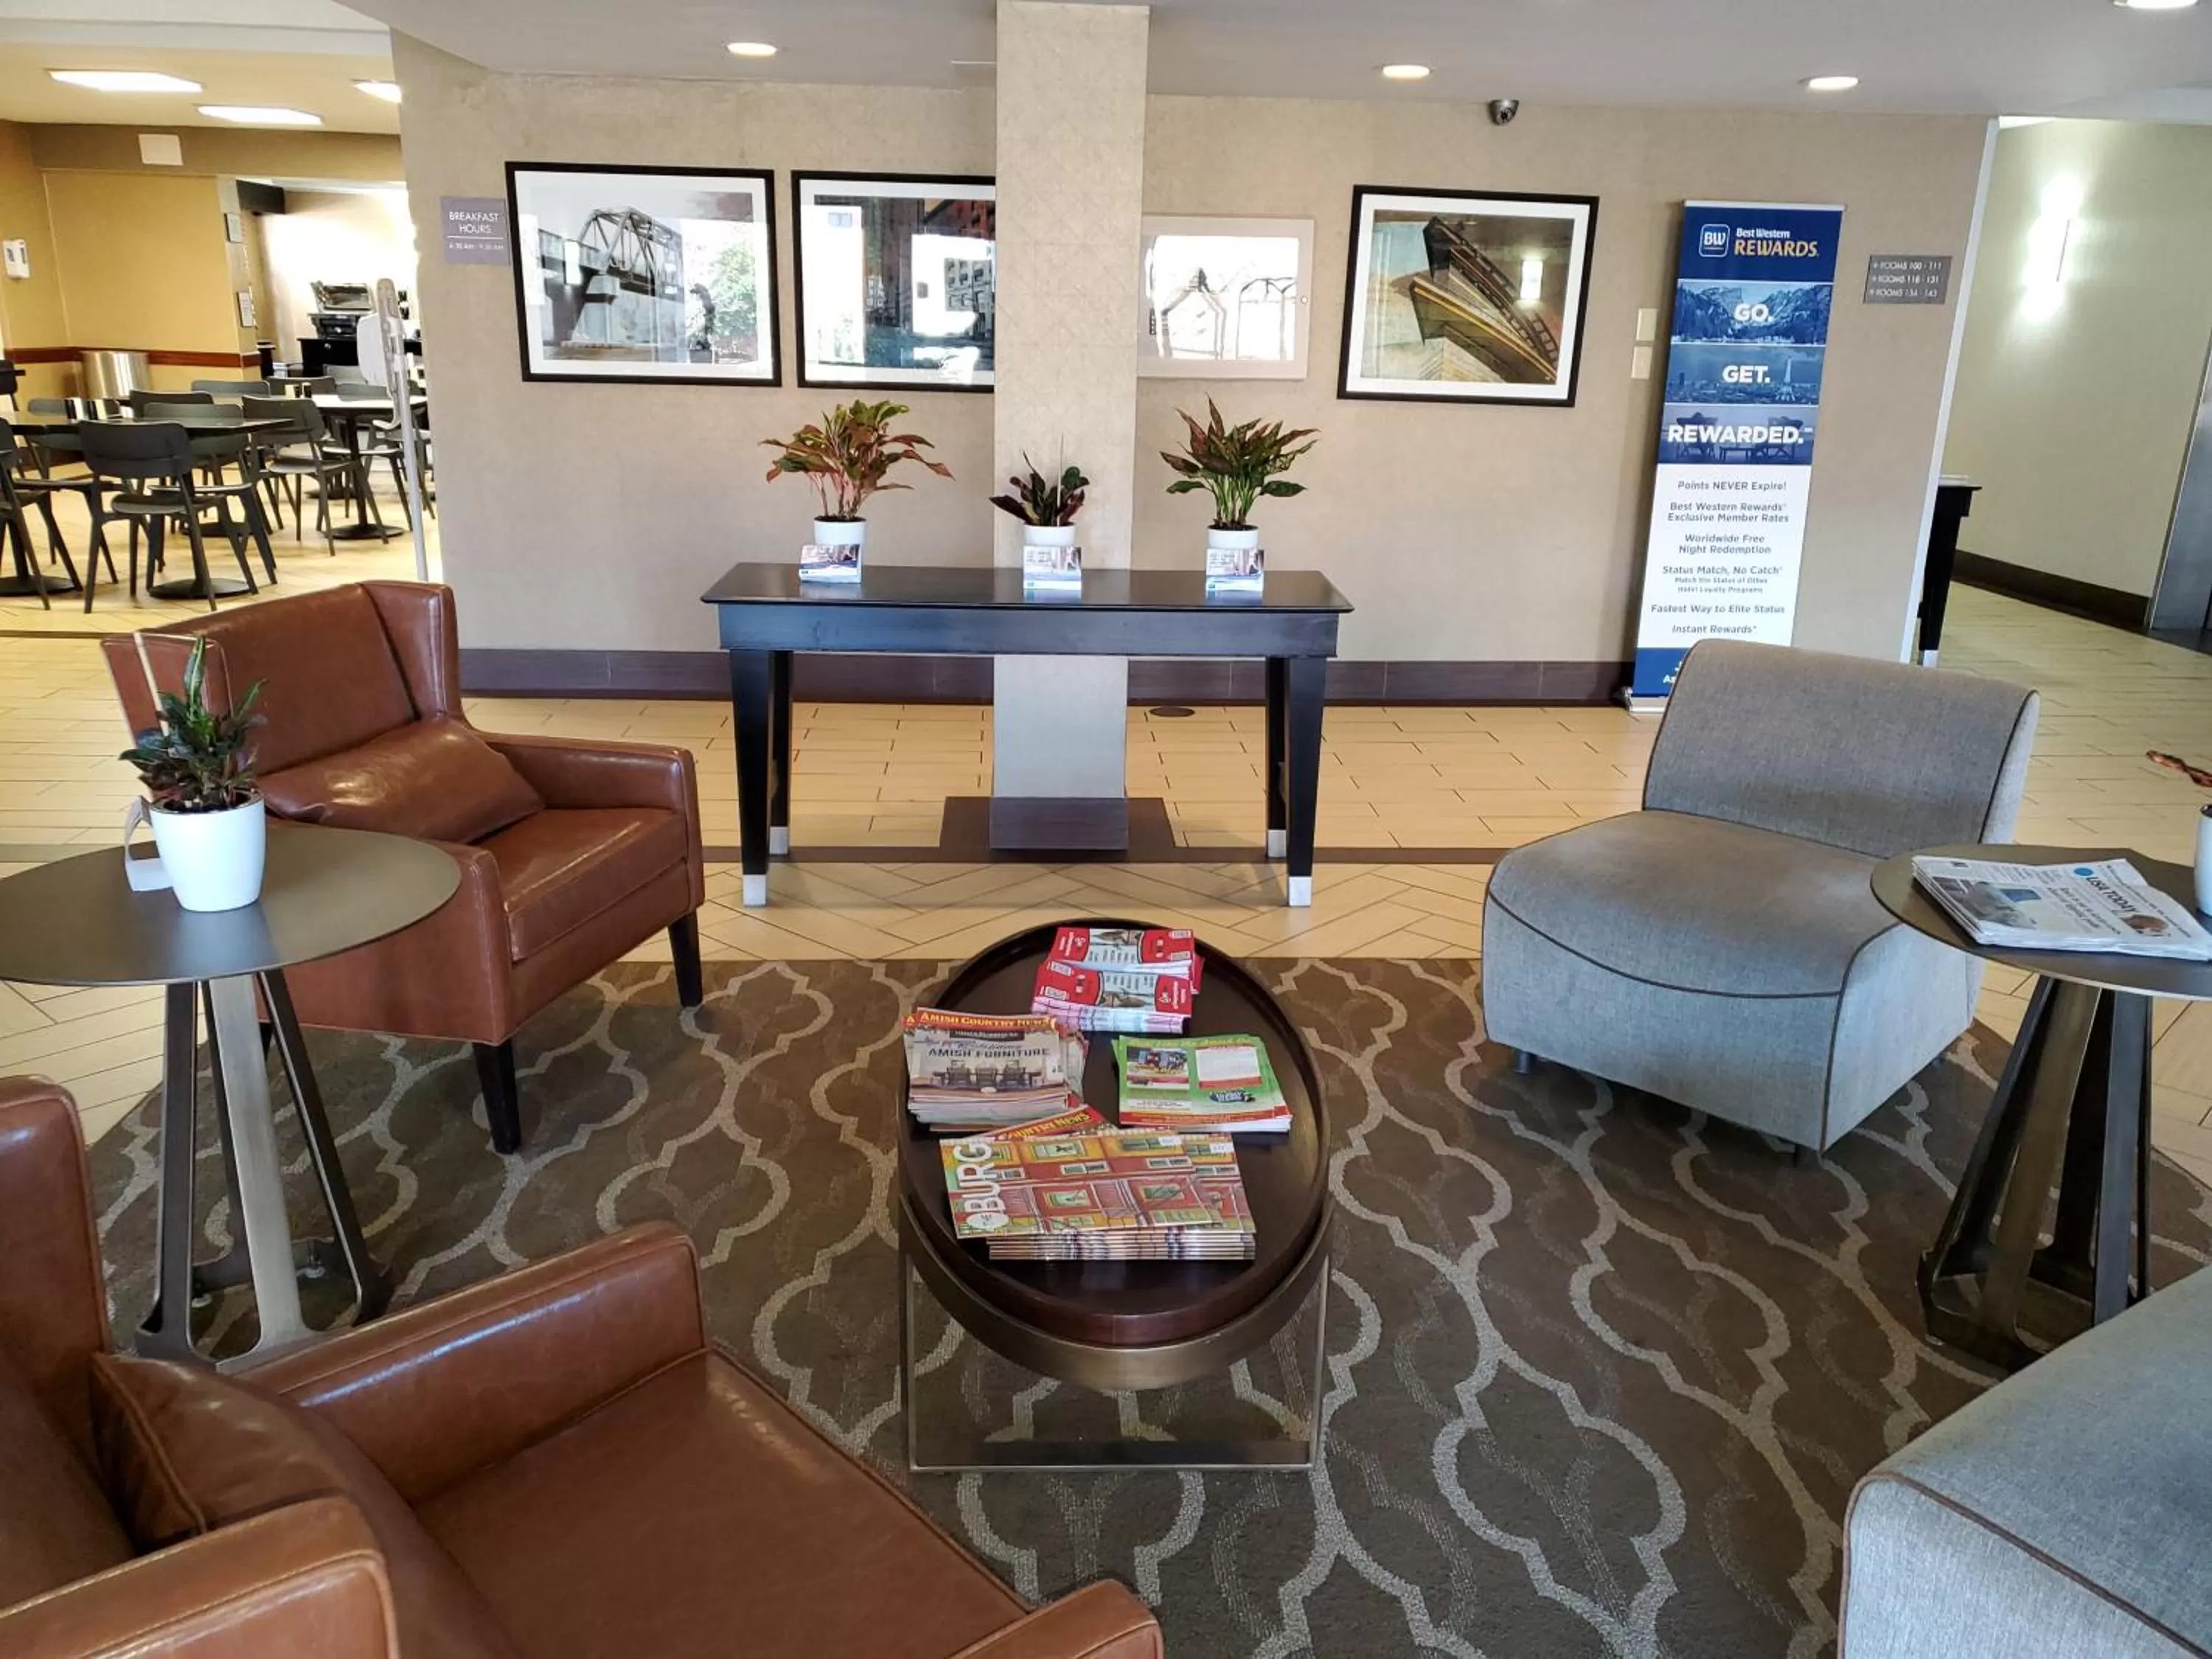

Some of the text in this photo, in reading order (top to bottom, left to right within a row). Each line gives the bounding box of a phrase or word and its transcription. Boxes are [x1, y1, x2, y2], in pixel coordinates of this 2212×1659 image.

[448, 212, 499, 222] BREAKFAST
[459, 223, 492, 234] HOURS
[1736, 227, 1790, 238] Best Western
[1703, 232, 1726, 246] BW
[1734, 240, 1818, 257] REWARDS
[1879, 261, 1907, 270] ROOMS
[1878, 274, 1905, 283] ROOMS
[1876, 288, 1903, 297] ROOMS
[1734, 303, 1773, 322] GO.
[1722, 365, 1770, 383] GET.
[1667, 425, 1804, 444] REWARDED.
[1677, 481, 1787, 492] Points NEVER Expire!
[1670, 502, 1692, 511] Best
[1696, 502, 1738, 511] Western
[1668, 512, 1790, 522] Exclusive Member Rates
[1685, 534, 1764, 543] Worldwide Free
[1679, 545, 1771, 554] Night Redemption
[1663, 566, 1694, 574] Status
[1697, 566, 1731, 576] Match,
[1733, 566, 1747, 574] No
[1651, 604, 1686, 613] Fastest
[1691, 605, 1711, 614] Way
[1728, 605, 1751, 613] Elite
[1753, 605, 1785, 613] Status
[1672, 625, 1706, 633] Instant
[920, 1012, 960, 1024] AMISH
[961, 1016, 1015, 1027] COUNTRY
[928, 1047, 1051, 1059] AMISH FURNITURE
